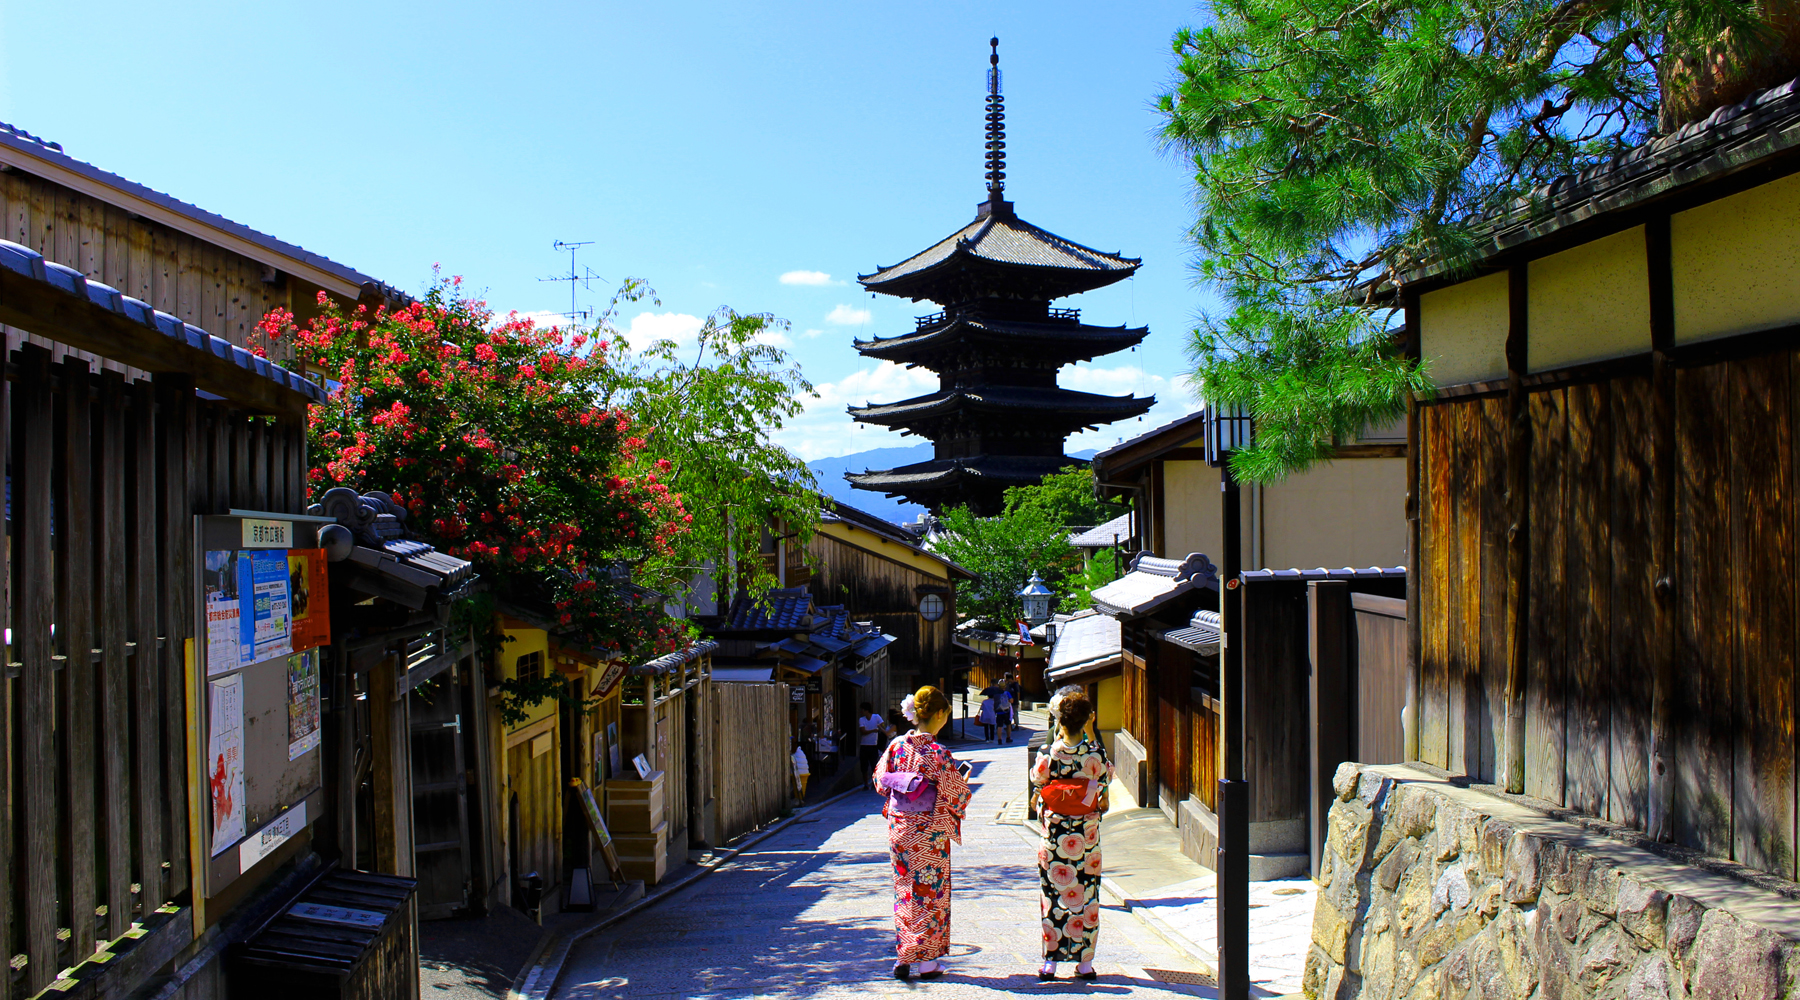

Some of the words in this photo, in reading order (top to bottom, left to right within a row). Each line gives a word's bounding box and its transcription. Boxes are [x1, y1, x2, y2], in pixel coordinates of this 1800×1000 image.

[253, 525, 285, 543] 京都市広報板
